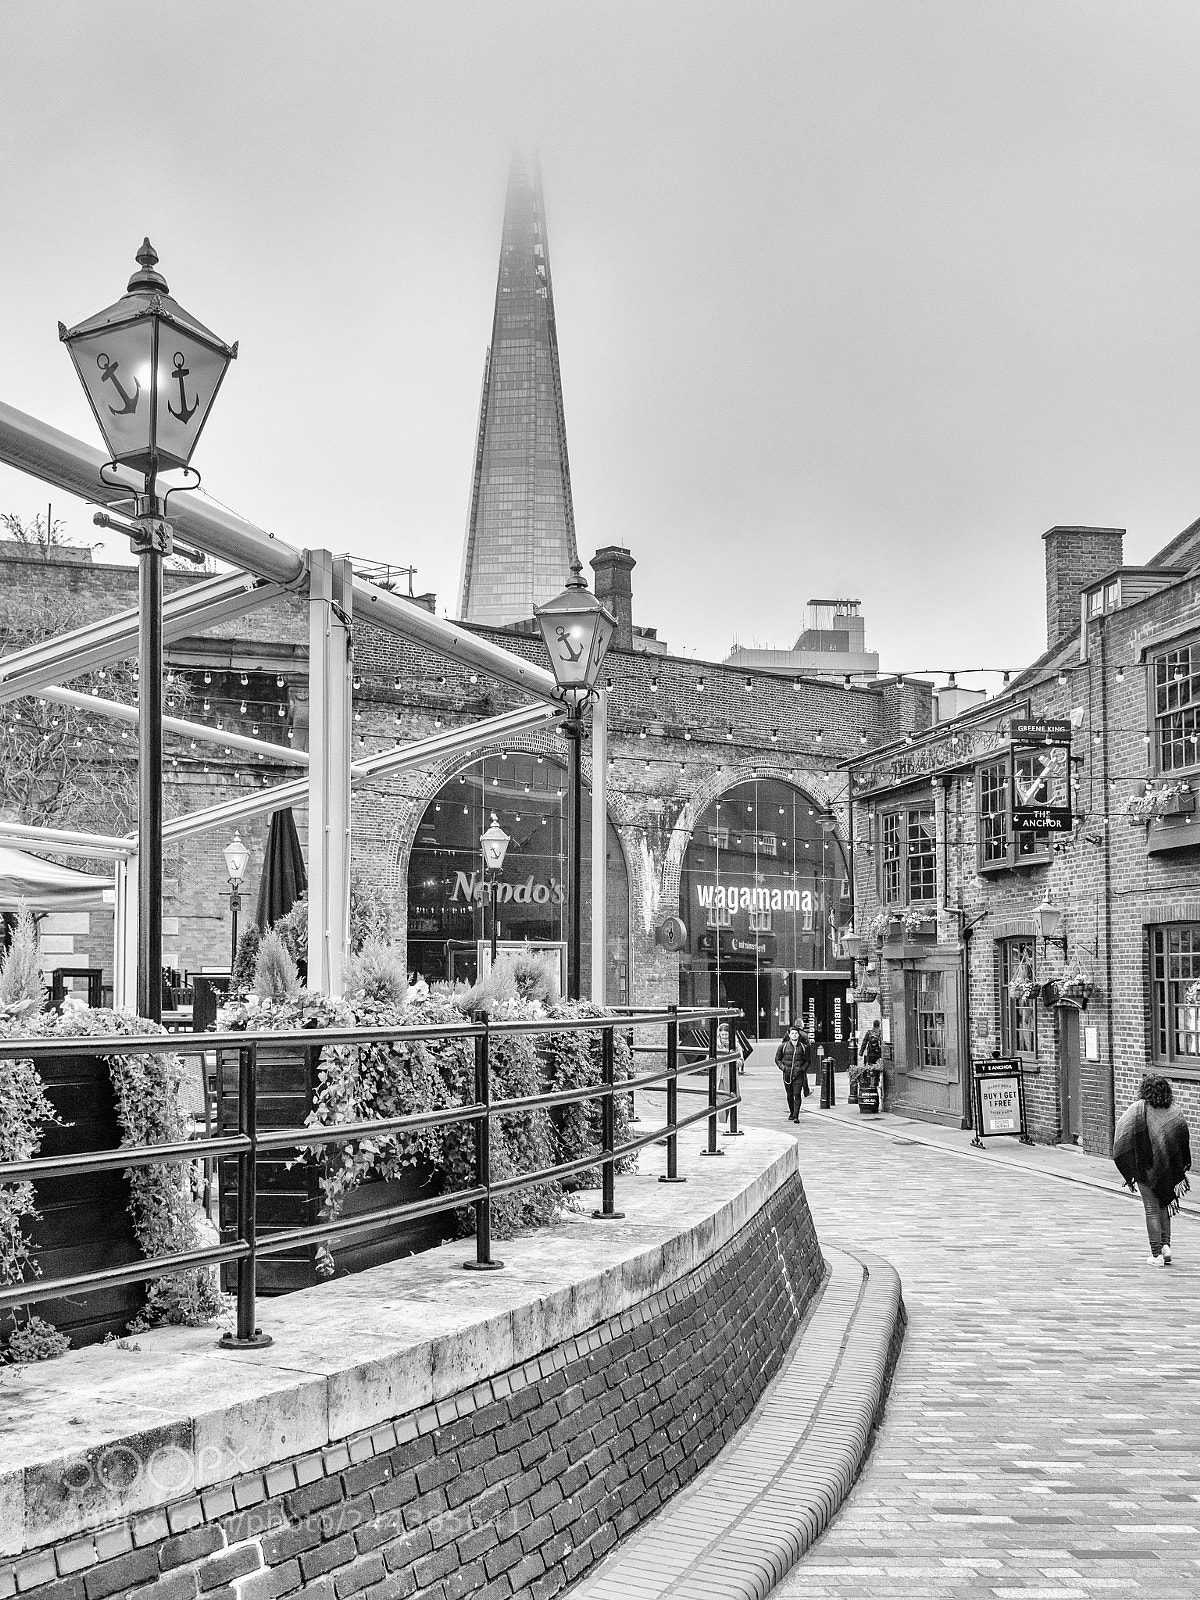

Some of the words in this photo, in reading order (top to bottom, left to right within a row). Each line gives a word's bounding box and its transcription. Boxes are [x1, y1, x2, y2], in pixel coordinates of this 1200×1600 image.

[1017, 725, 1045, 733] GREENE
[1022, 819, 1062, 828] ANCHOR
[448, 870, 565, 904] Nando's
[696, 884, 812, 915] wagamama
[983, 1092, 997, 1100] BUY
[1004, 1091, 1017, 1099] GET
[994, 1099, 1012, 1107] FREE
